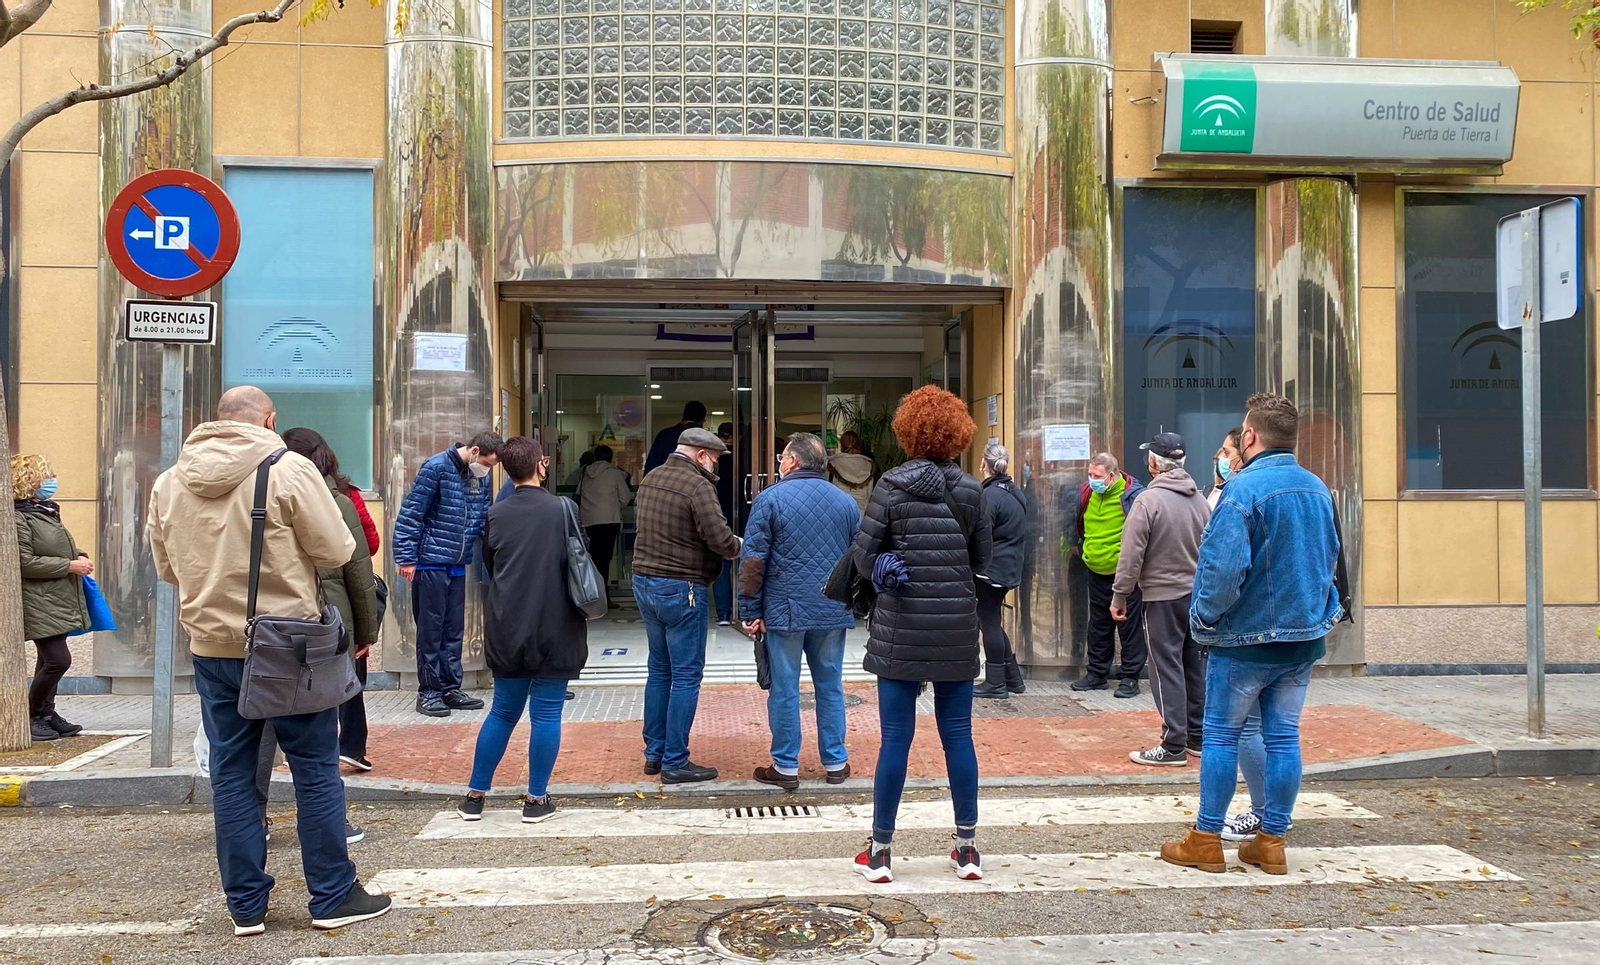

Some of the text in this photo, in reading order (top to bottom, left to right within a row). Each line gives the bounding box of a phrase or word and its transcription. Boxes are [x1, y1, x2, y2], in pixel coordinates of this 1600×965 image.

[1363, 99, 1501, 123] Centro de Salud
[1402, 126, 1439, 141] Puerta
[1442, 127, 1456, 141] de
[1461, 127, 1491, 142] Tierra
[162, 219, 184, 246] P
[134, 310, 206, 325] URGENCIAS
[133, 325, 142, 333] de
[1141, 378, 1237, 389] JUNTA DE ANDALUCIA
[1449, 378, 1521, 389] JUNTA DE ANDAL
